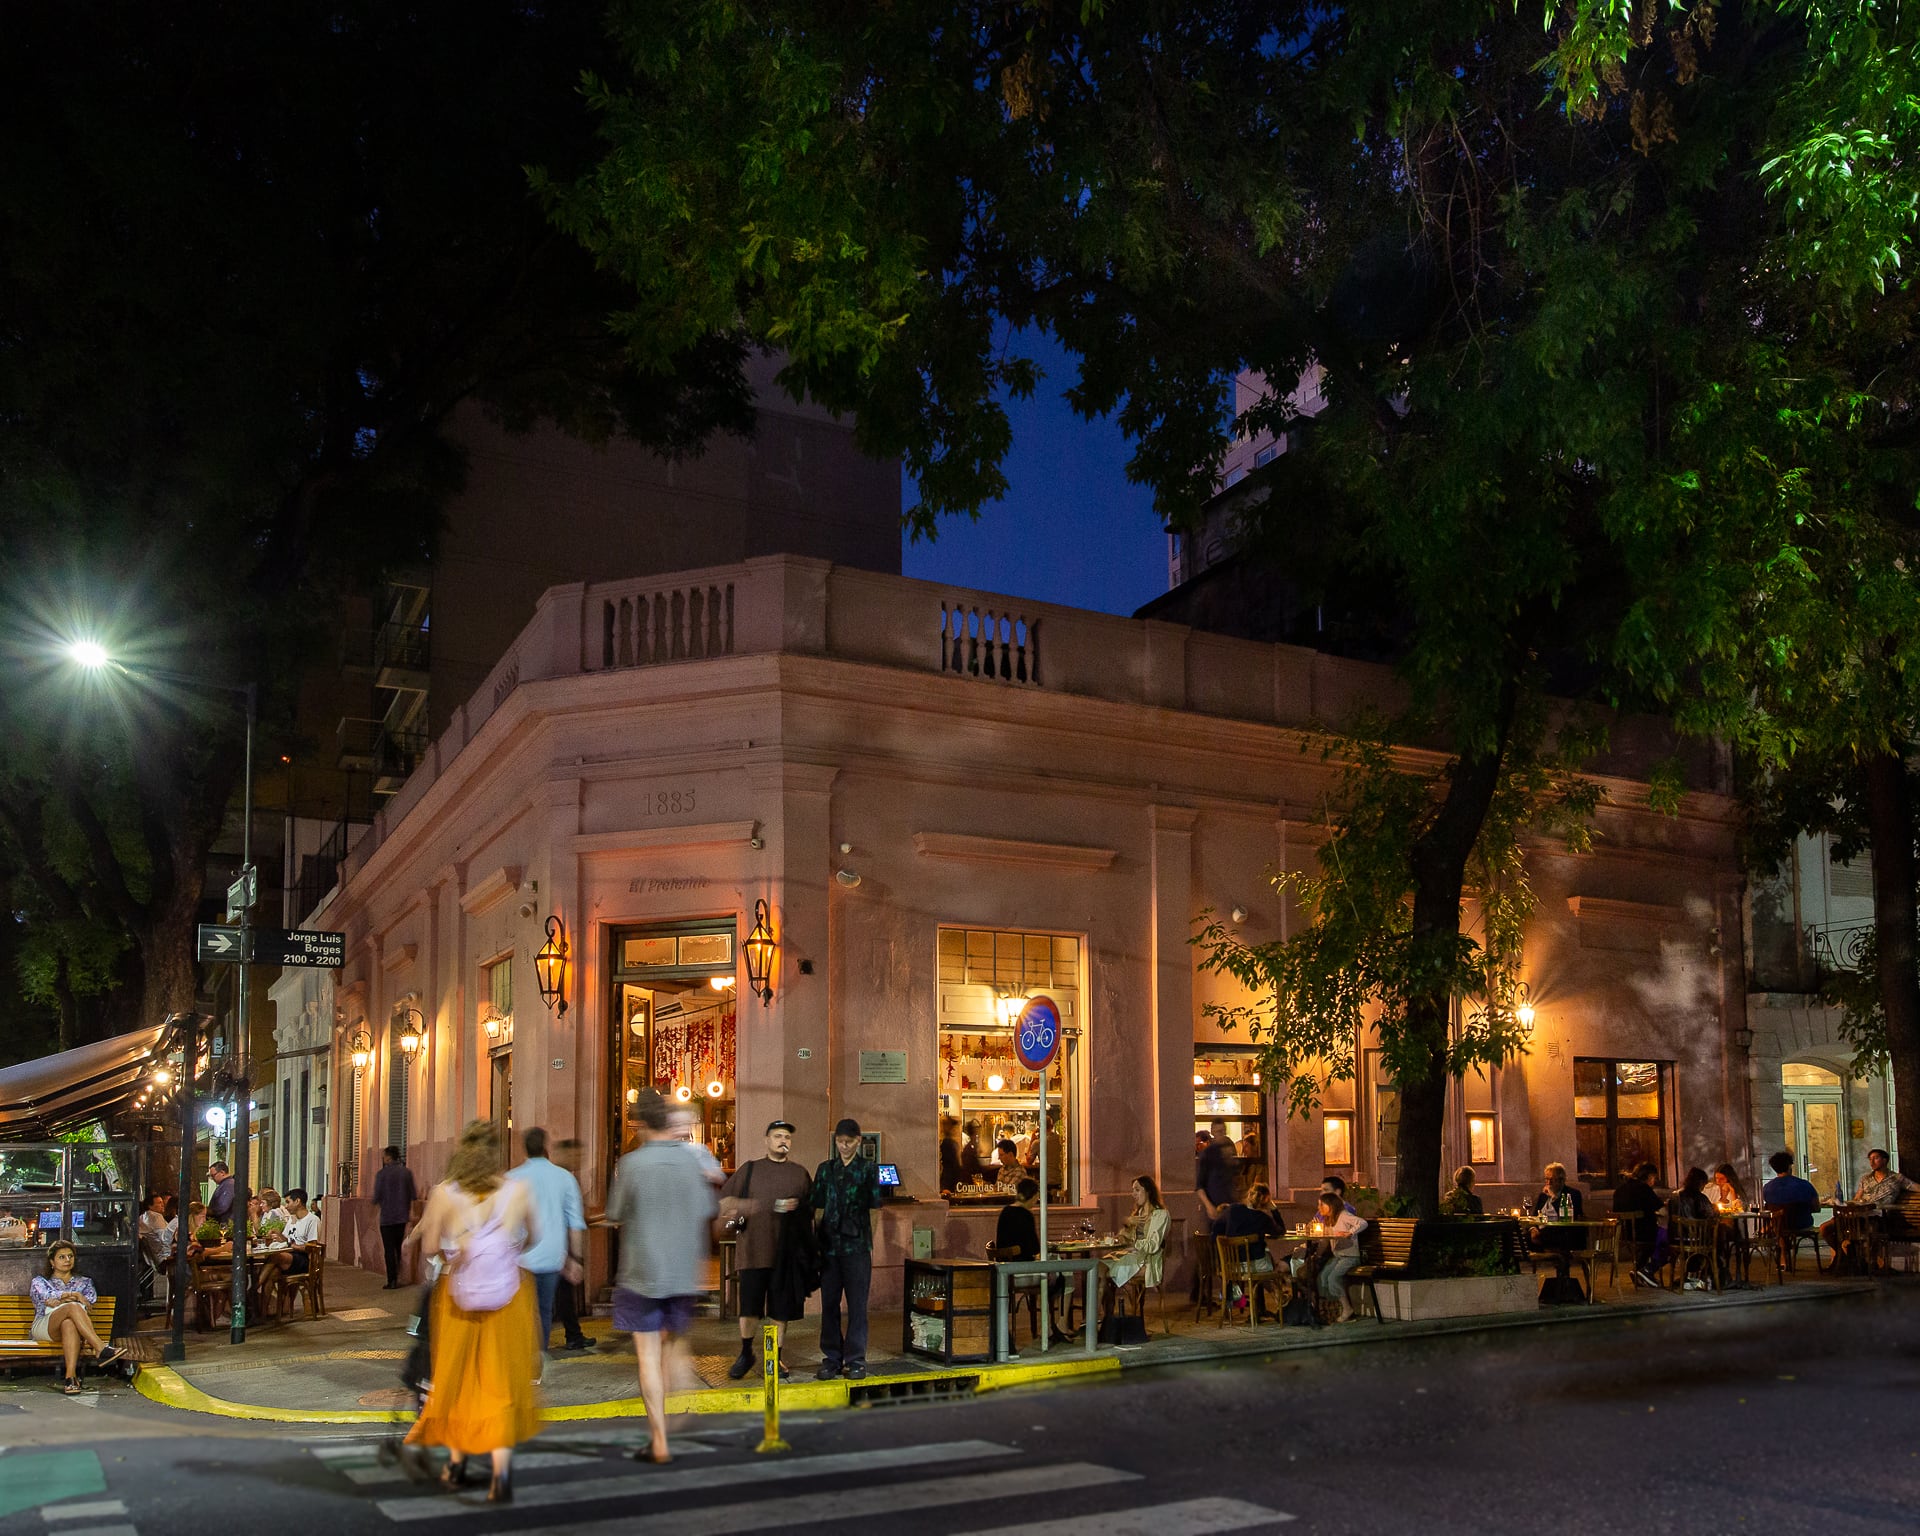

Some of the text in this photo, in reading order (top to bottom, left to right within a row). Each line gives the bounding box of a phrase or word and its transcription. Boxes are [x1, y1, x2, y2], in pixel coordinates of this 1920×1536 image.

[644, 789, 696, 816] 1885
[287, 931, 341, 944] Jorge Luis
[305, 943, 341, 955] Borges
[283, 954, 307, 964] 2100
[316, 956, 341, 966] 2200
[956, 1180, 1017, 1193] Comidas Para
